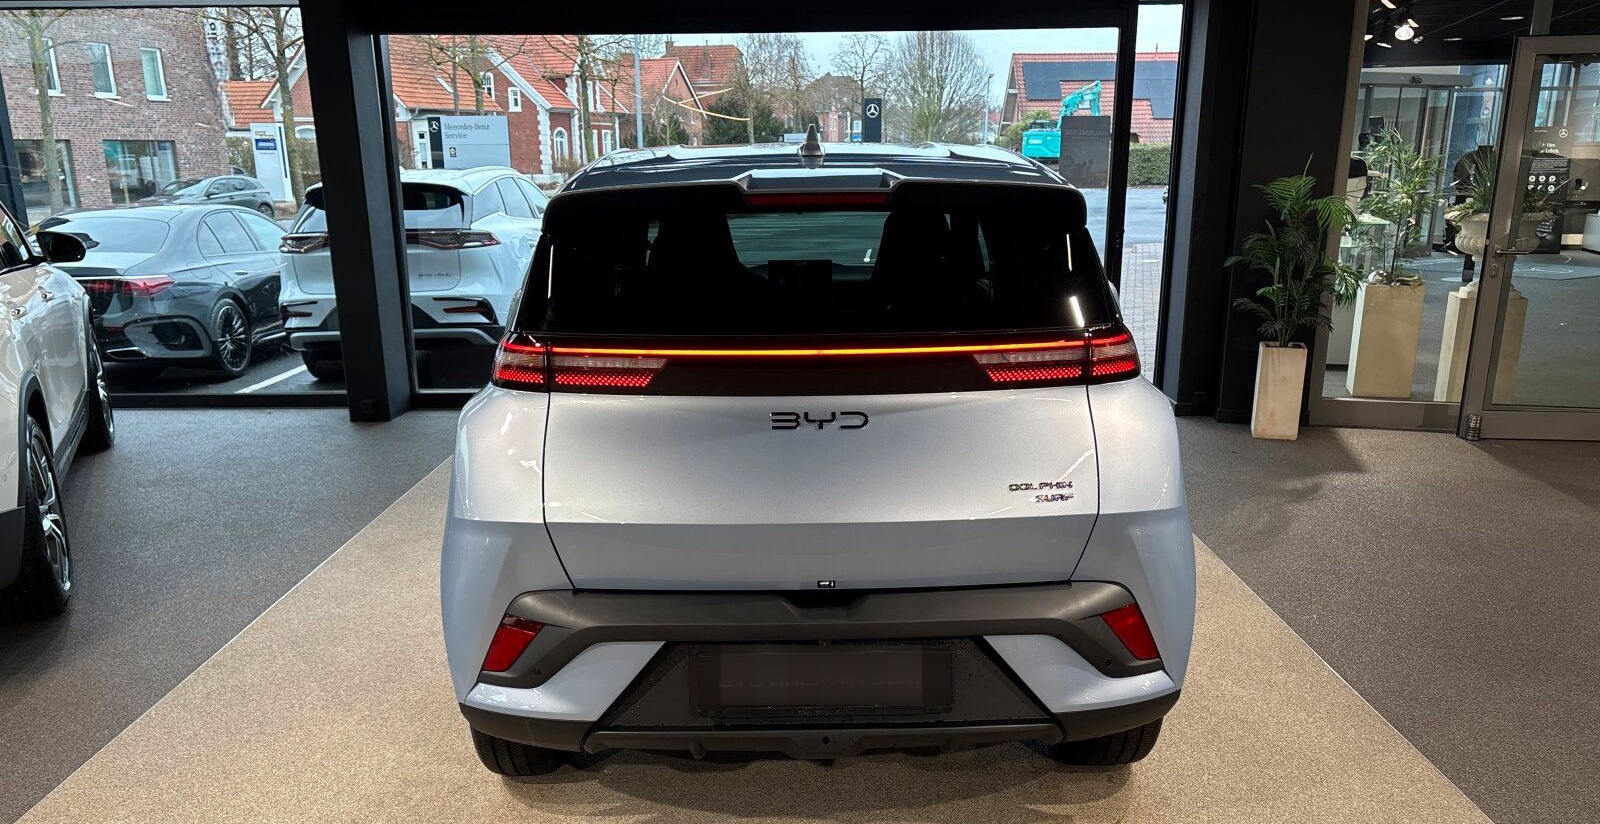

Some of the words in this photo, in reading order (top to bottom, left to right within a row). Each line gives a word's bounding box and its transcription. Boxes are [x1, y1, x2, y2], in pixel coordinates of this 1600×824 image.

[444, 123, 490, 131] Mercedes-Benz
[769, 411, 869, 430] BYD
[1008, 481, 1073, 491] DOLPHIN
[1034, 493, 1074, 502] SURF
